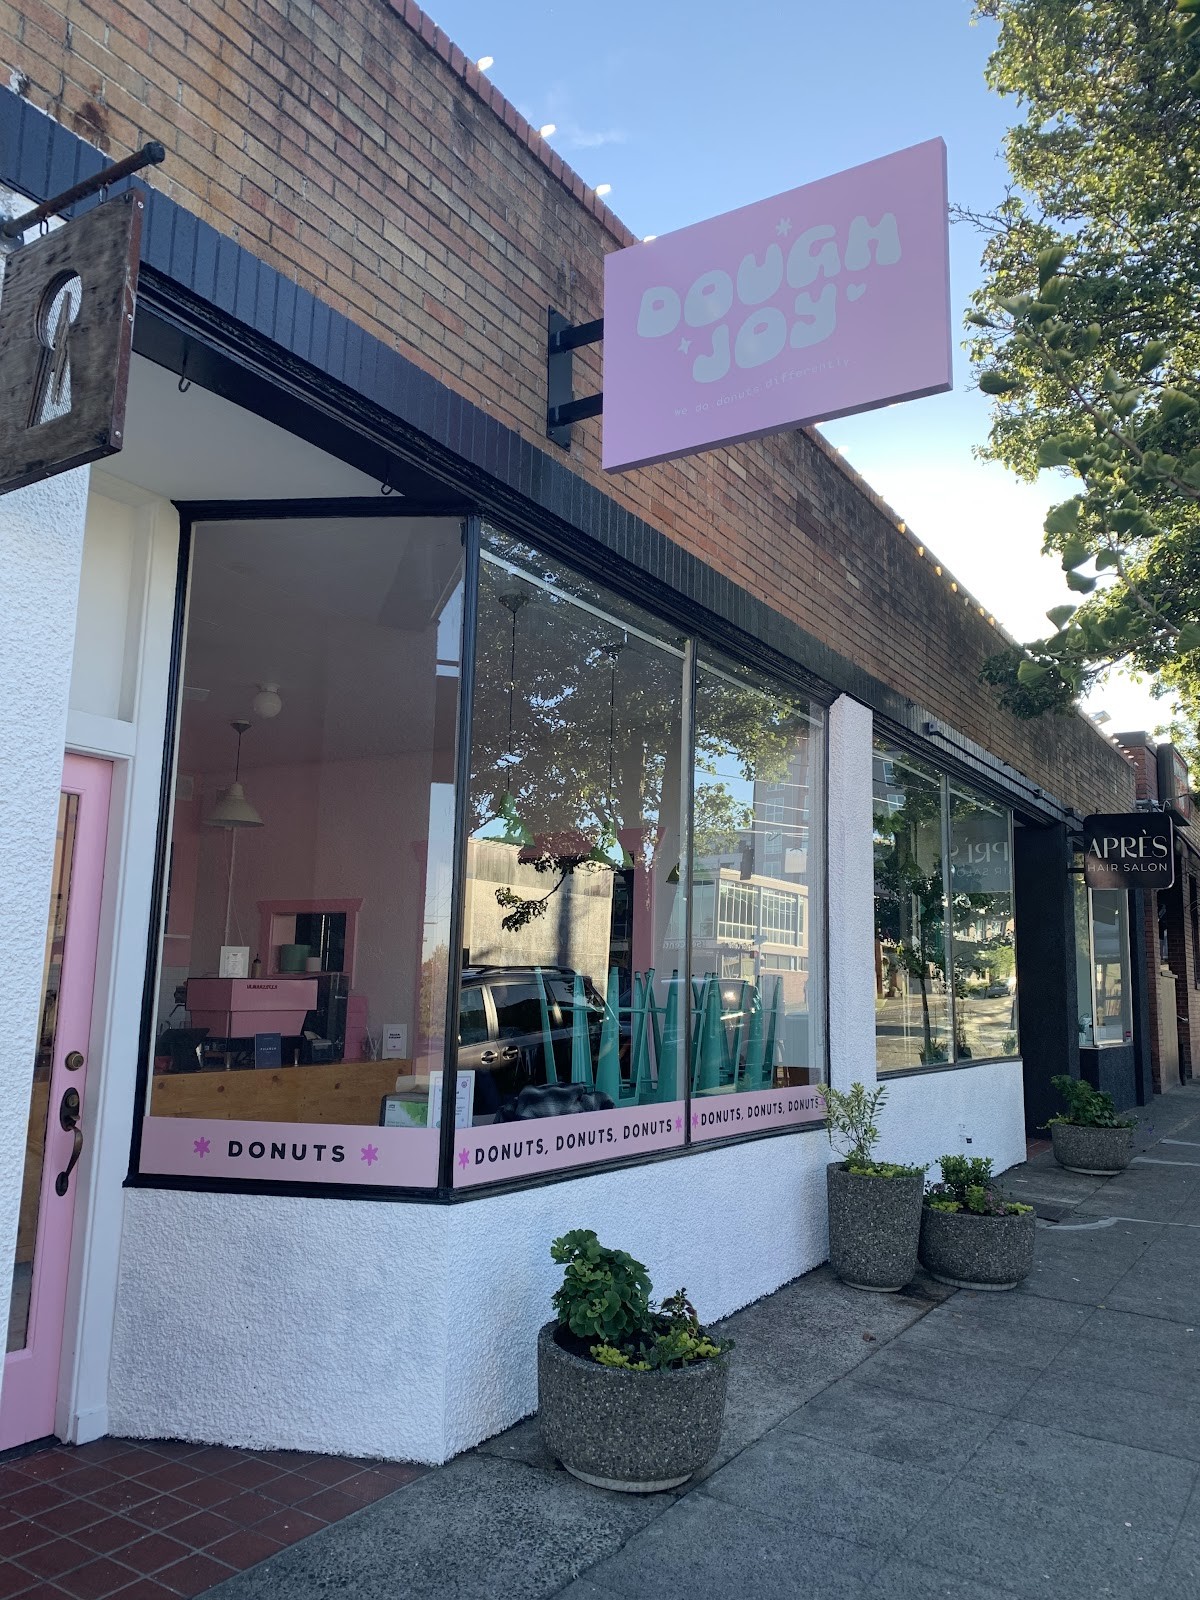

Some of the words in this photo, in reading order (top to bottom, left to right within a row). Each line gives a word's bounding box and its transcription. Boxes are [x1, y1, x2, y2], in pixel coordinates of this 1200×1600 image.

[636, 211, 902, 338] DOUGH
[692, 282, 838, 384] JOY
[673, 408, 689, 417] we
[695, 402, 709, 413] do
[1087, 829, 1168, 858] APRÈS
[1087, 863, 1119, 872] HAIR
[1123, 862, 1168, 872] SALON
[701, 1107, 744, 1127] DONUTS,
[747, 1101, 785, 1119] DONUTS,
[788, 1097, 820, 1113] DONUTS
[227, 1140, 345, 1163] DONUTS
[474, 1138, 550, 1165] DONUTS,
[556, 1127, 618, 1151] DONUTS,
[623, 1118, 672, 1140] DONUTS
